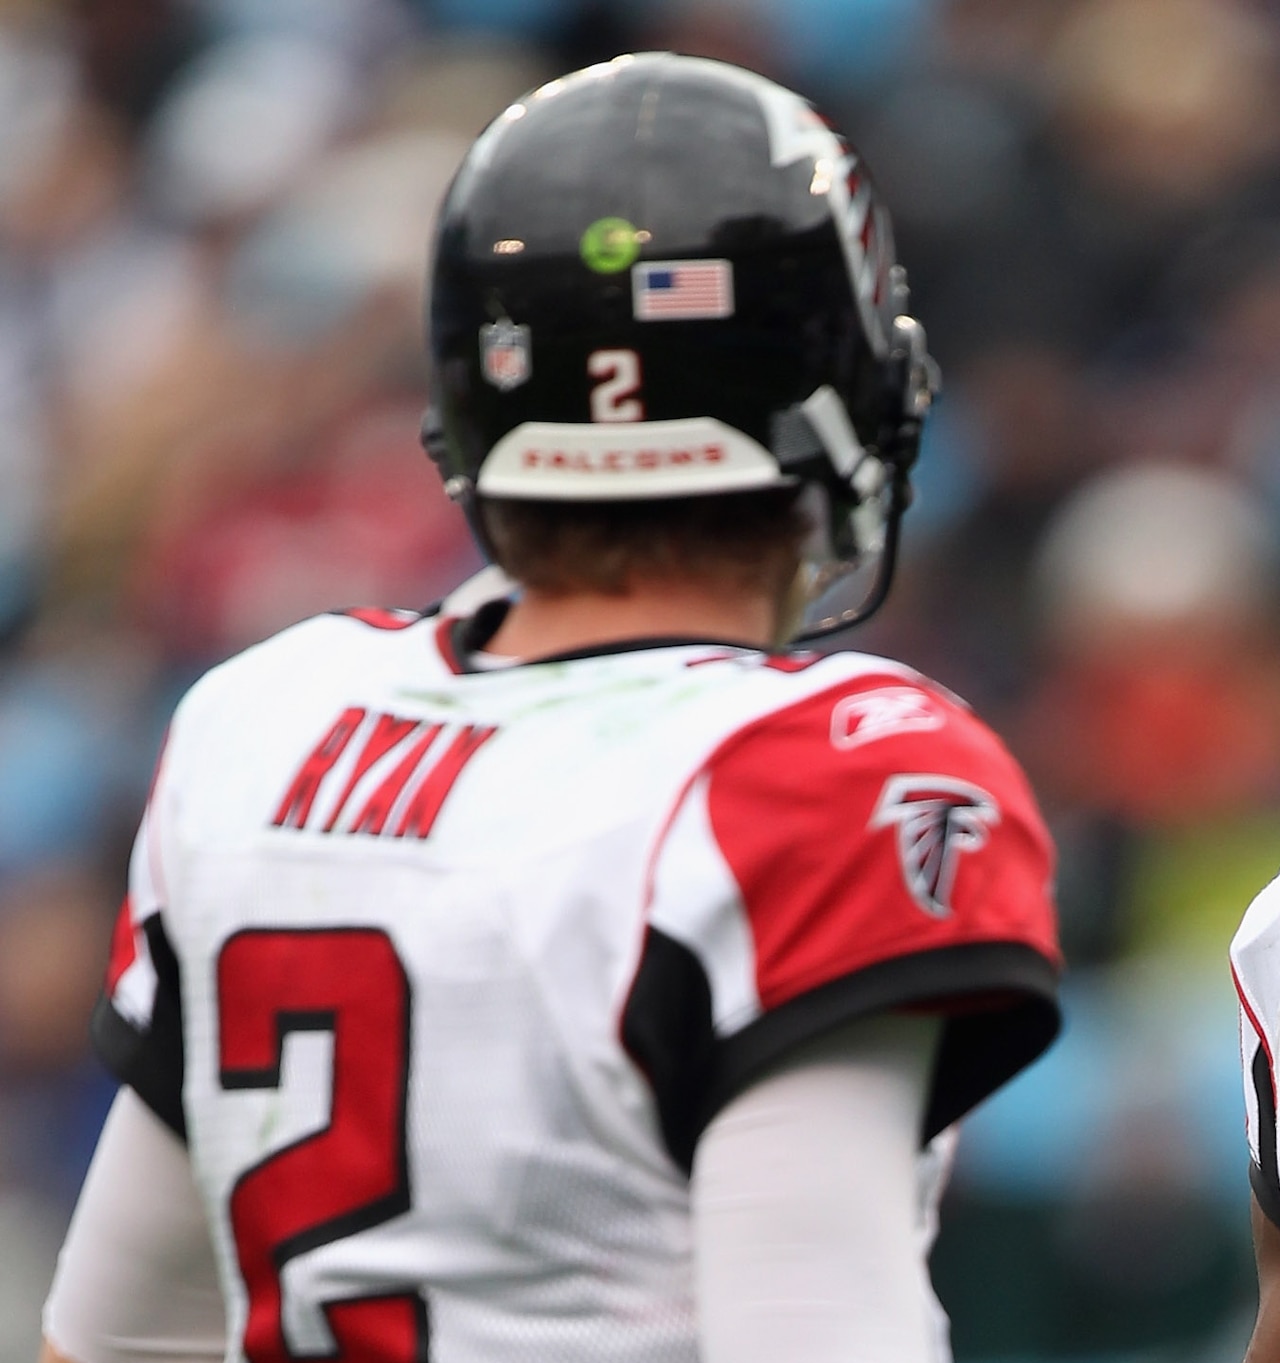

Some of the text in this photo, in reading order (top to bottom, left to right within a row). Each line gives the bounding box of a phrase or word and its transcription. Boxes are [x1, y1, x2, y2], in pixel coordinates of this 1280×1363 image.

[587, 348, 646, 423] 2
[523, 444, 727, 473] FALCONS
[271, 706, 500, 840] RYAN
